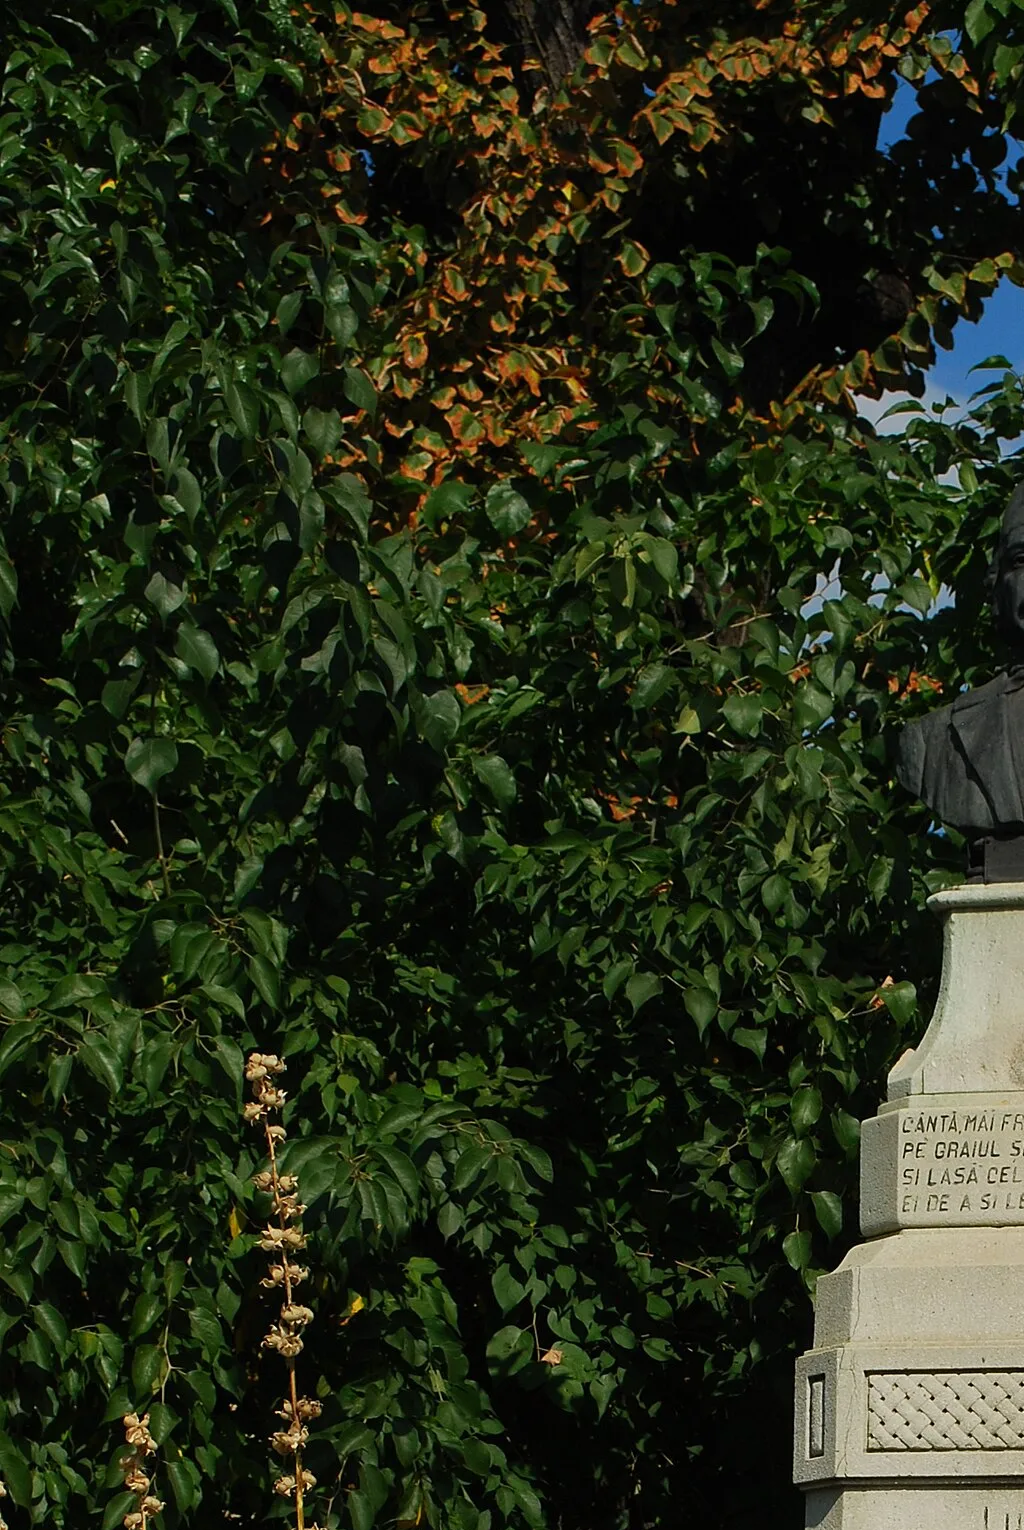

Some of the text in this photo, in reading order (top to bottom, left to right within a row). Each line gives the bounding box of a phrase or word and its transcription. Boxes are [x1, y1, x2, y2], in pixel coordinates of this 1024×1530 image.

[903, 1141, 927, 1159] PE
[935, 1140, 1000, 1159] GRAIUL
[927, 1194, 950, 1212] DE
[960, 1193, 972, 1212] A
